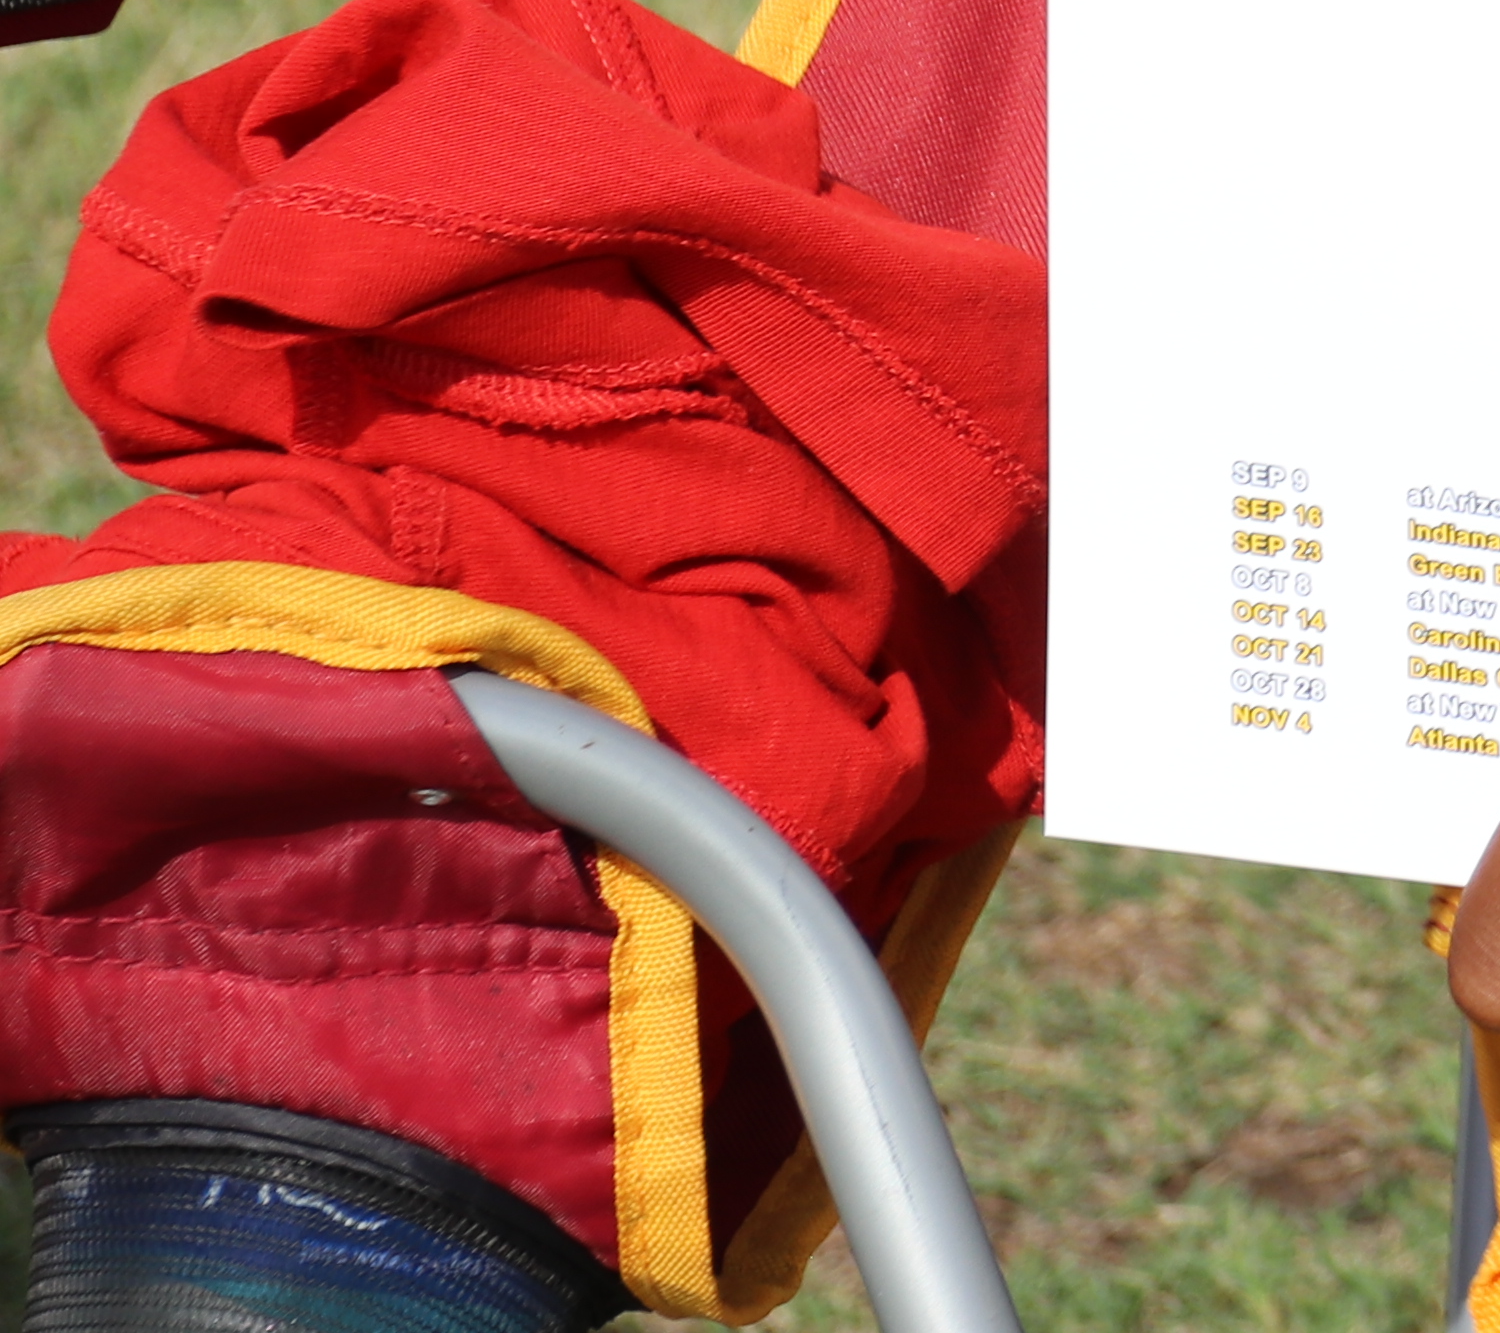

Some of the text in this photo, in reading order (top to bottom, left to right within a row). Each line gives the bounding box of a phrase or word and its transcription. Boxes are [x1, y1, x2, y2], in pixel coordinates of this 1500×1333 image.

[1232, 461, 1285, 488] SEP
[1292, 469, 1307, 492] 9
[1408, 486, 1433, 509] at
[1232, 496, 1286, 522] SEP
[1293, 504, 1323, 528] 16
[1232, 530, 1286, 557] SEP
[1292, 538, 1323, 563] 23
[1408, 553, 1486, 584] Green
[1232, 599, 1289, 627] OCT
[1296, 608, 1327, 632] 14
[1233, 565, 1289, 592] OCT
[1296, 573, 1310, 596] 8
[1408, 590, 1433, 612] at
[1443, 592, 1496, 619] New
[1232, 634, 1289, 662] OCT
[1295, 642, 1323, 666] 21
[1408, 656, 1488, 687] Dallas
[1232, 669, 1288, 696] OCT
[1295, 677, 1325, 702] 28
[1408, 693, 1433, 715] at
[1443, 696, 1497, 722] New
[1232, 703, 1291, 731] NOV
[1295, 712, 1313, 734] 4
[1407, 725, 1500, 757] Atlanta
